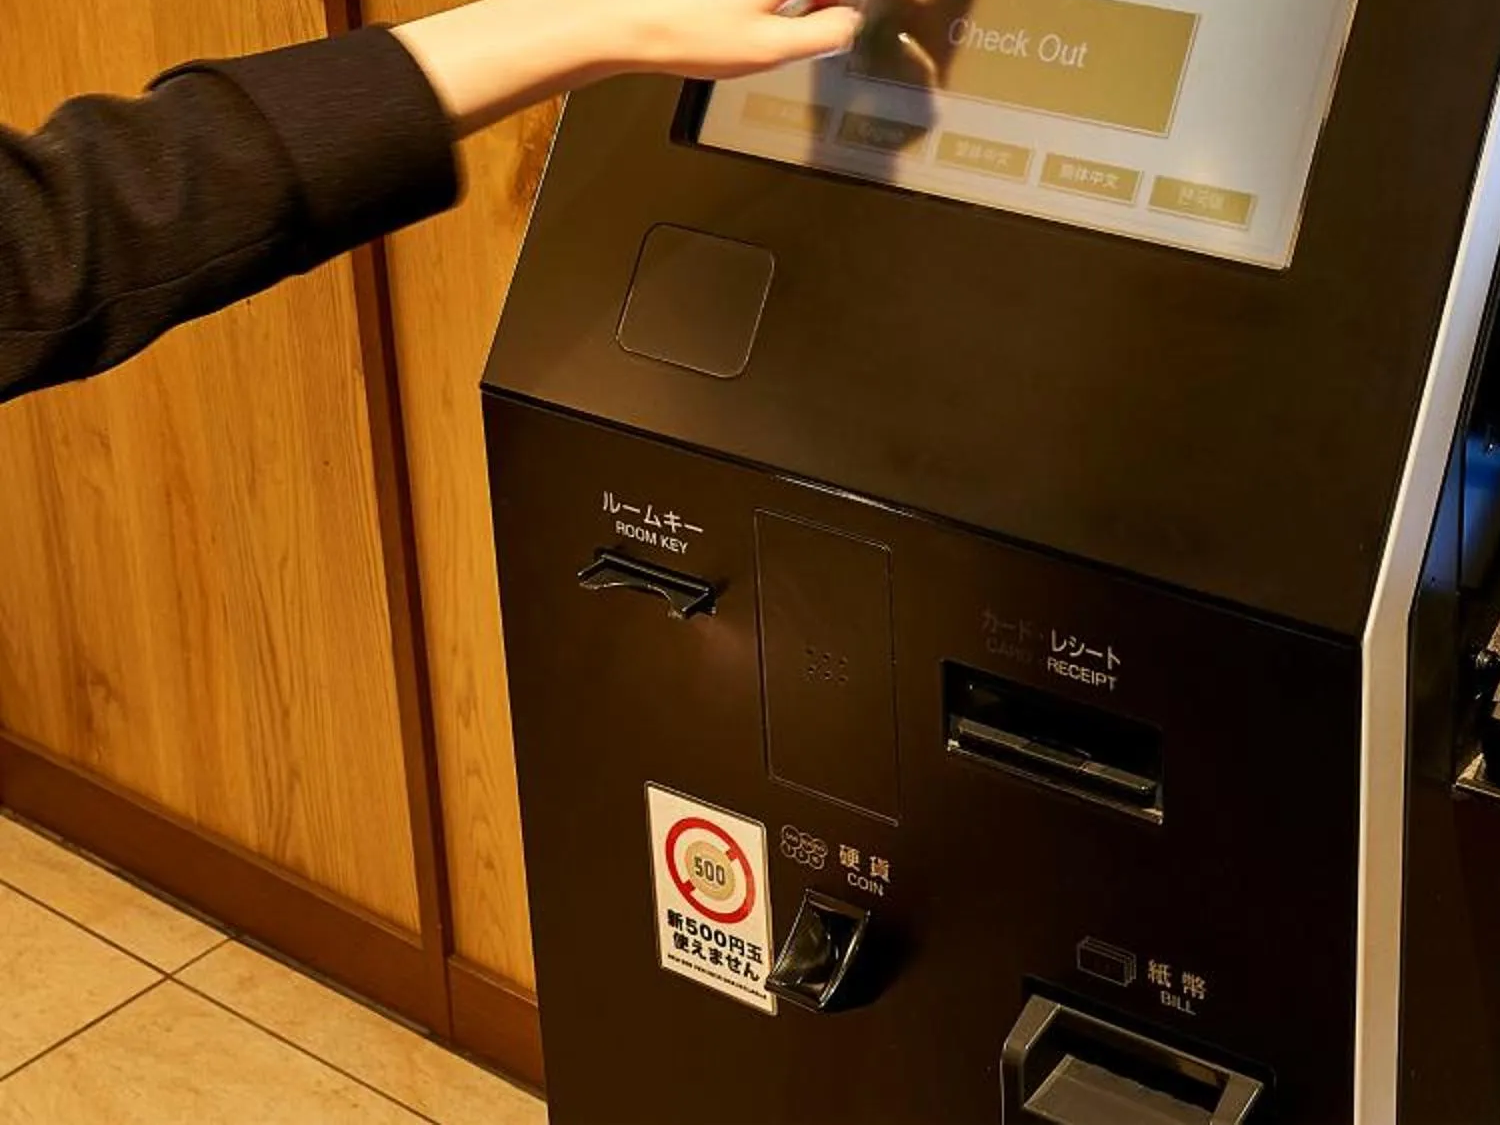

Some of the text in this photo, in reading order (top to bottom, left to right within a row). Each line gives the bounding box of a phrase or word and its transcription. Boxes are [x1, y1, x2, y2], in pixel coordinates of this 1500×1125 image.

[948, 17, 1089, 68] Check Out
[602, 490, 704, 533] ルームキー
[615, 519, 689, 555] ROOM KEY
[1050, 627, 1122, 671] レシート
[1047, 655, 1118, 693] RECEIPT
[693, 855, 727, 886] 500
[847, 872, 885, 897] COIN
[666, 908, 764, 964] 新500円玉
[673, 932, 761, 982] 使えません
[1160, 990, 1197, 1016] BILL
